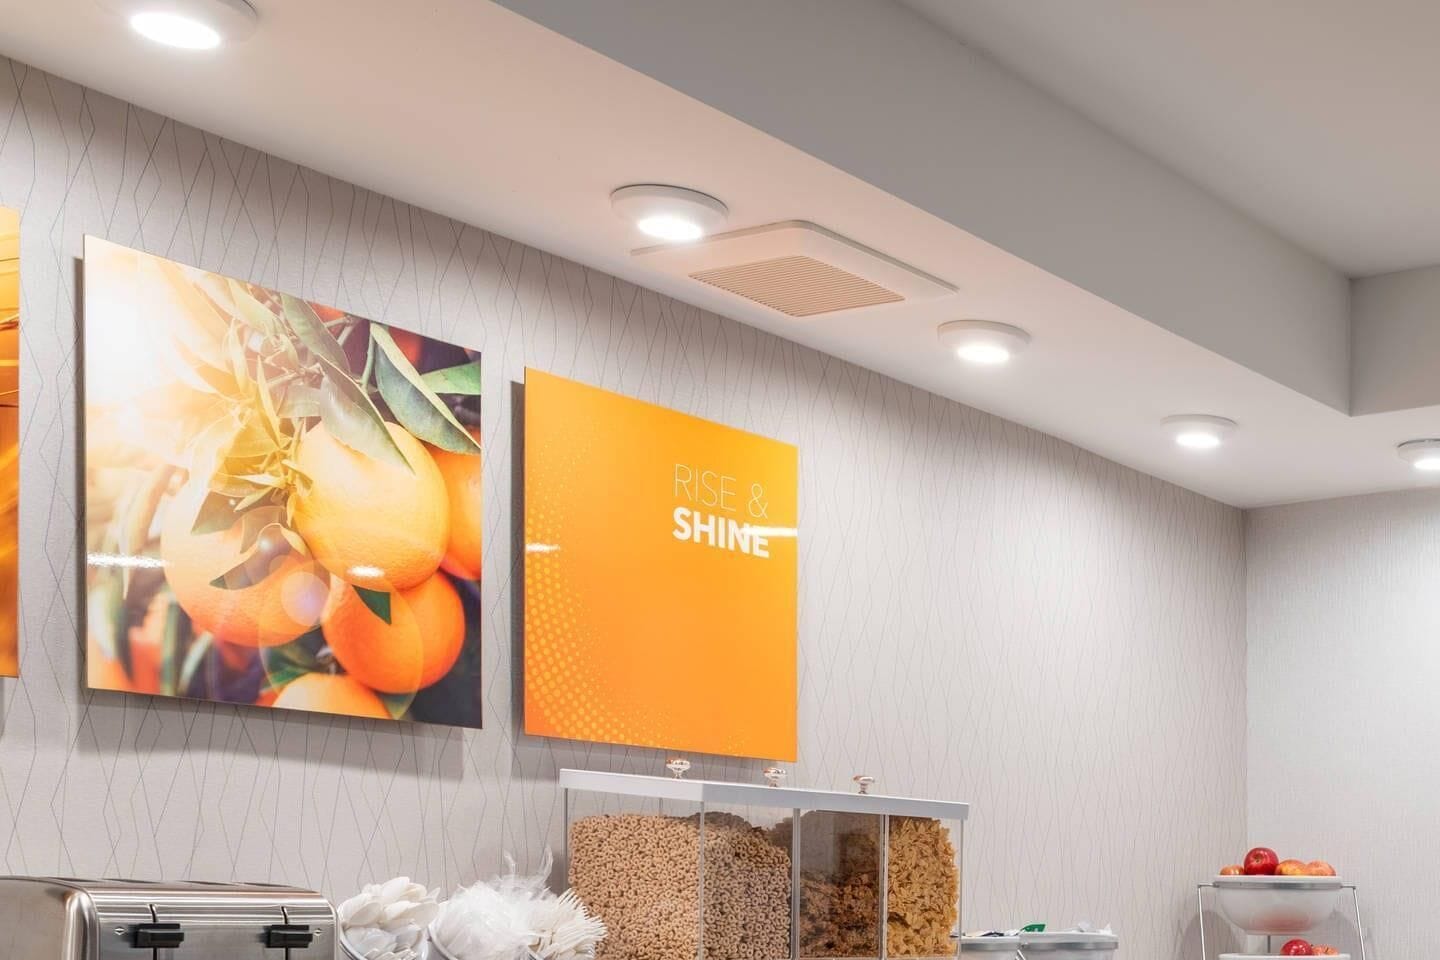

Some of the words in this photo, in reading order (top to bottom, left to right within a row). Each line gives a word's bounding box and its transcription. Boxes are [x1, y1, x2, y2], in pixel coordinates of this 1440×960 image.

[674, 463, 737, 512] RISE
[748, 483, 768, 519] &
[672, 506, 770, 558] SHINE
